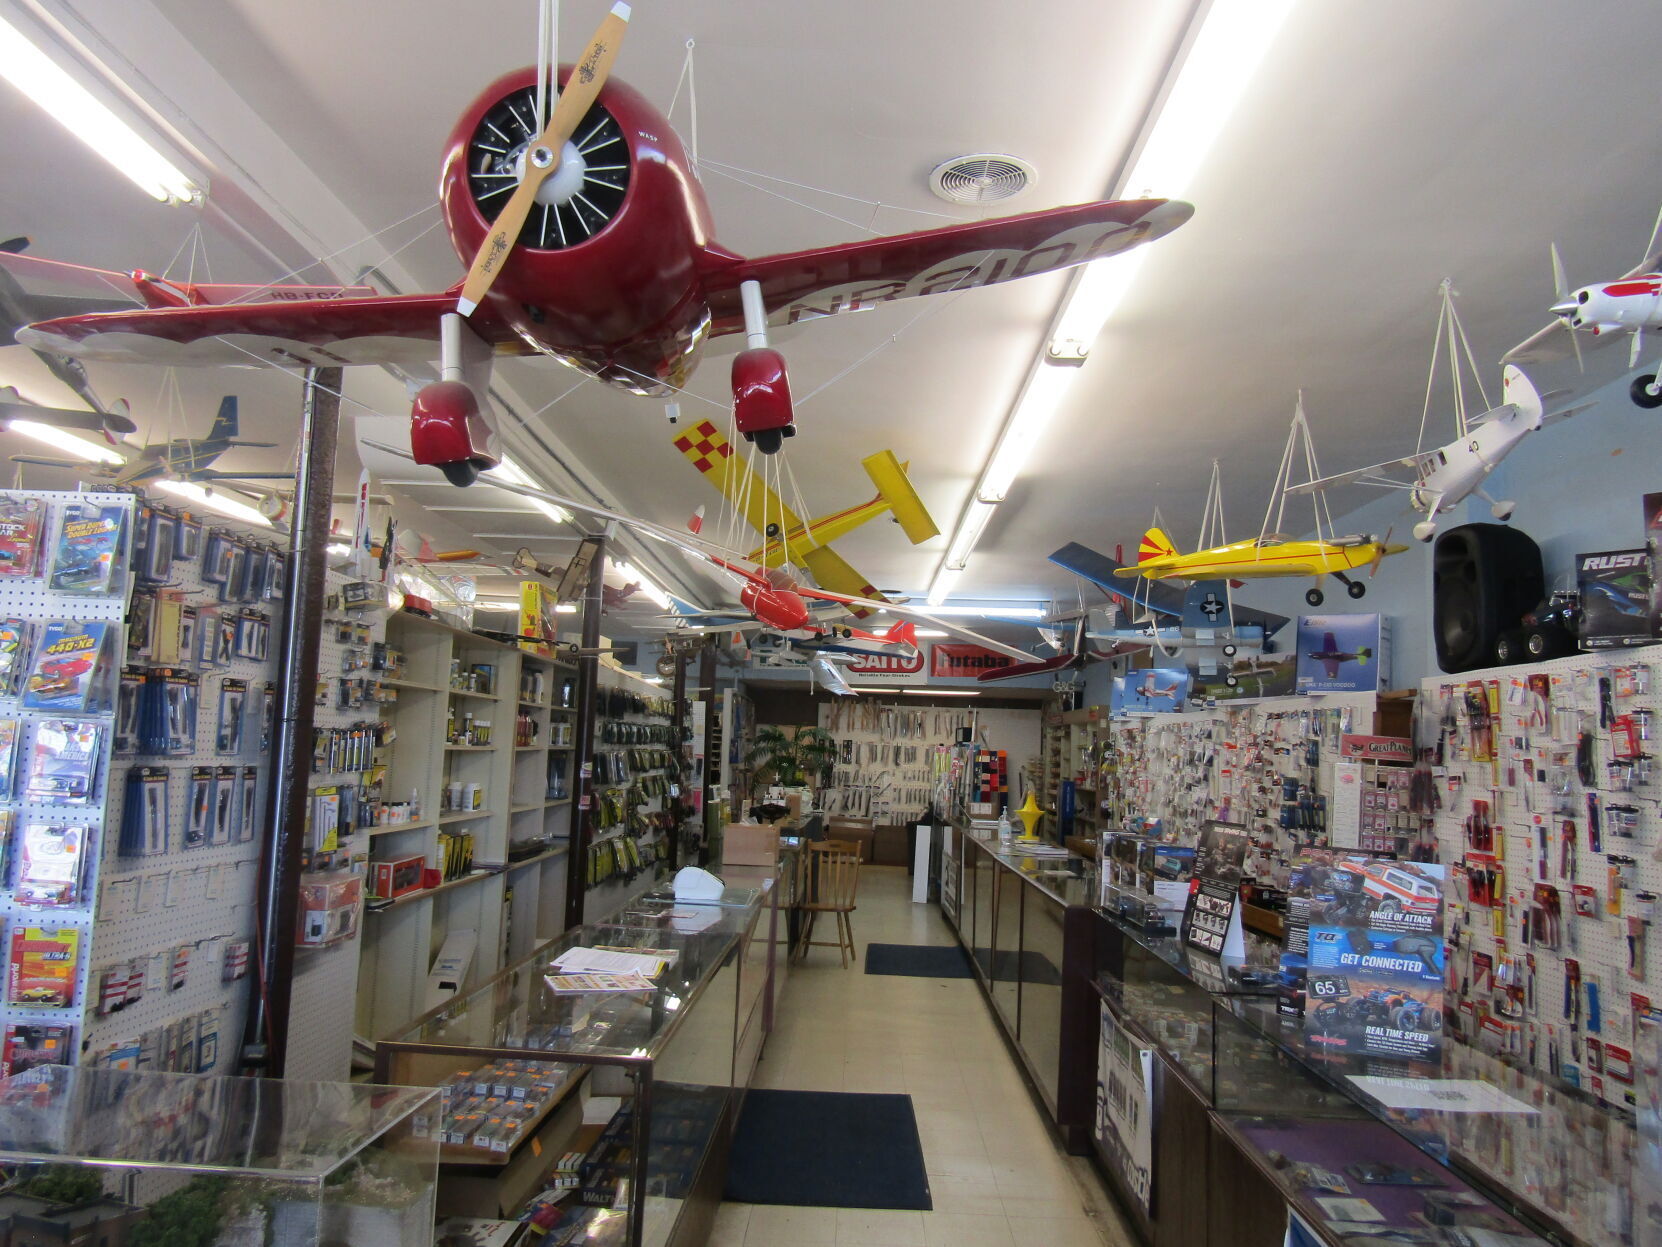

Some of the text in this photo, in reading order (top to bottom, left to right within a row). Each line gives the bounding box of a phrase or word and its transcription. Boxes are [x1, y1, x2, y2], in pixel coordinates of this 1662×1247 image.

[638, 131, 658, 142] WASP
[1582, 552, 1649, 571] RUST
[852, 652, 1010, 669] SAITO Futaba
[1369, 910, 1433, 924] ANGLE OF ATTACK
[1340, 953, 1360, 965] GET
[1362, 955, 1423, 973] CONNECTED
[1314, 981, 1336, 995] 65
[1365, 1025, 1429, 1042] REAL TIME SPEED
